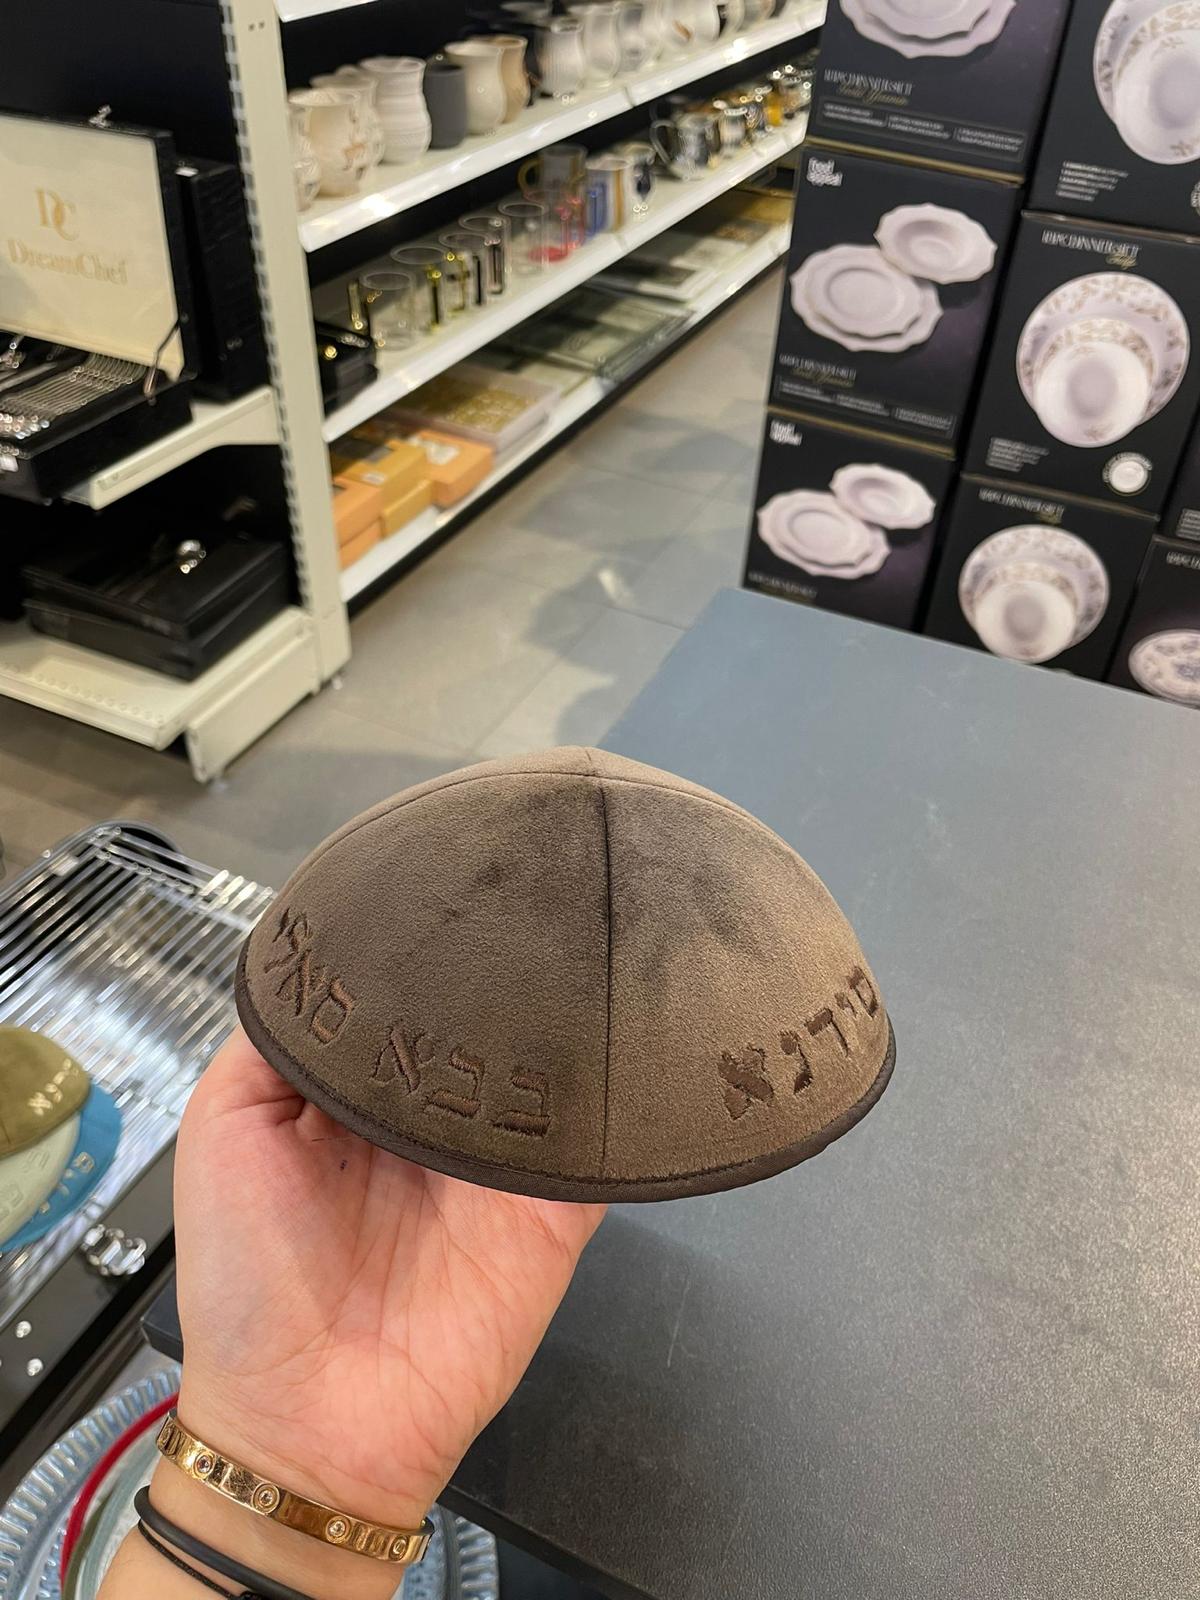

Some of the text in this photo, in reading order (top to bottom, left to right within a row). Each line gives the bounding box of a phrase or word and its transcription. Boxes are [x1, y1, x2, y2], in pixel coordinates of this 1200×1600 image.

[7, 237, 128, 286] DreamChef
[263, 907, 879, 1138] סידנא בבא סאלי
